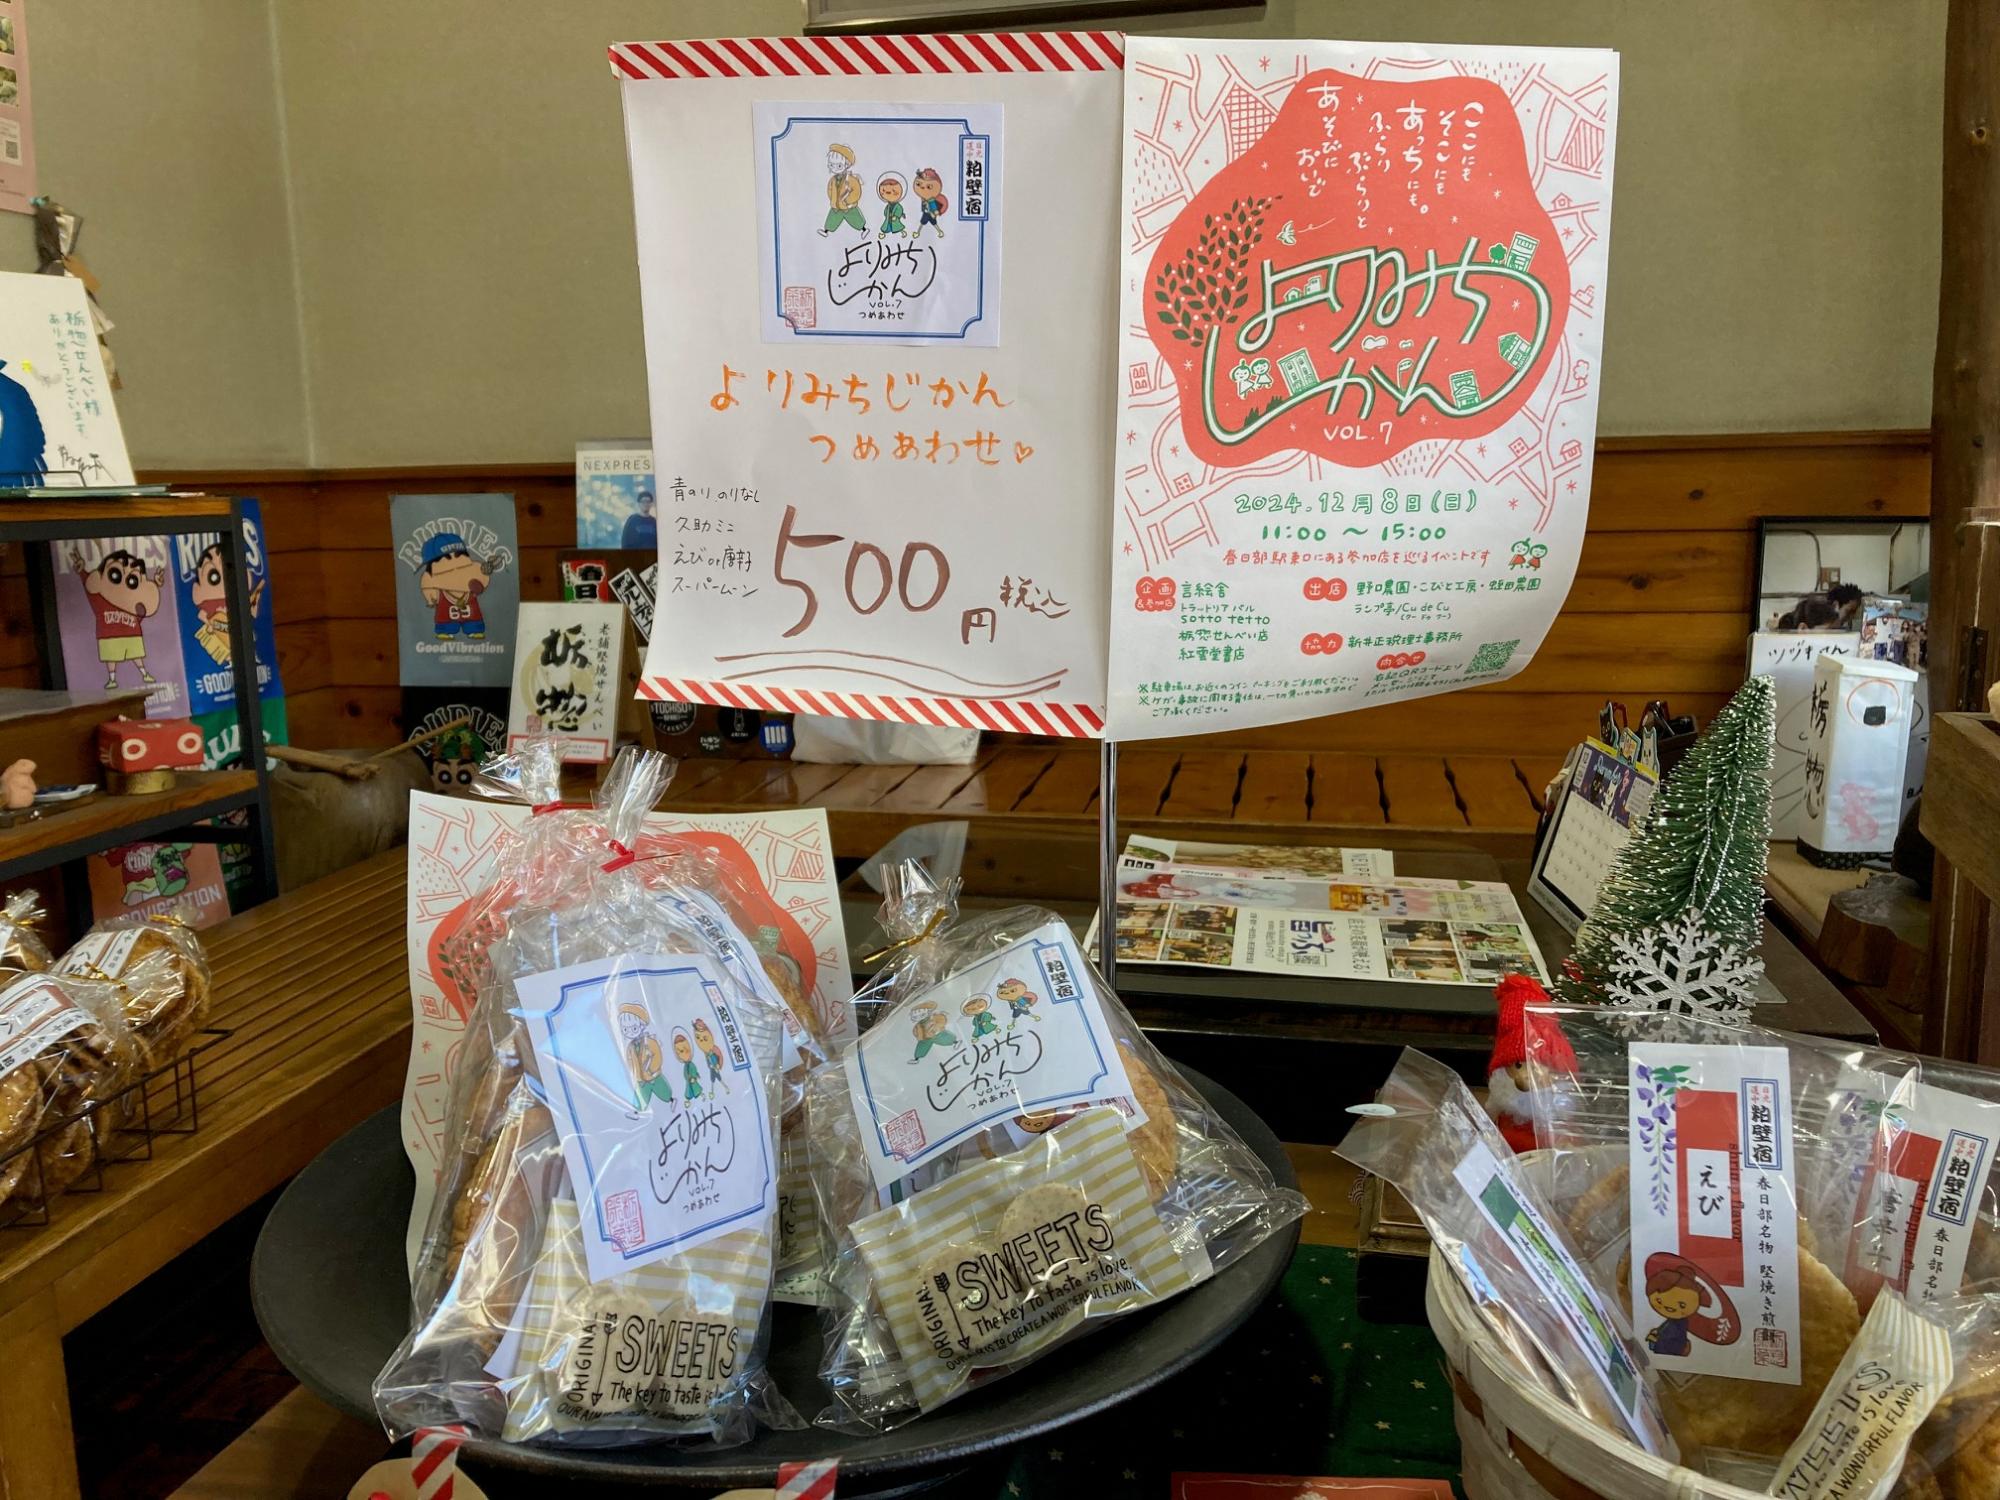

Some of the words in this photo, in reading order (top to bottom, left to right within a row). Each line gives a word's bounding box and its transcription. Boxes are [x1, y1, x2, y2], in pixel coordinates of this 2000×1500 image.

[1306, 81, 1343, 168] あそびに
[1370, 112, 1393, 173] ふらり
[1434, 110, 1457, 195] そこにも
[1462, 102, 1485, 183] ここにも
[1296, 149, 1326, 197] おいで
[838, 239, 924, 277] よりみち
[858, 311, 906, 321] つめあわせ
[710, 364, 1014, 414] よりみちじかん
[1751, 1105, 1774, 1165] 粕壁宿
[1697, 1164, 1725, 1217] えび
[1755, 1175, 1773, 1256] 春日部名物
[956, 1204, 1115, 1313] SWEETS
[616, 1315, 738, 1381] SWEETS
[1839, 1421, 1895, 1490] WONDERFUL
[1887, 1380, 1926, 1426] FLAVOR
